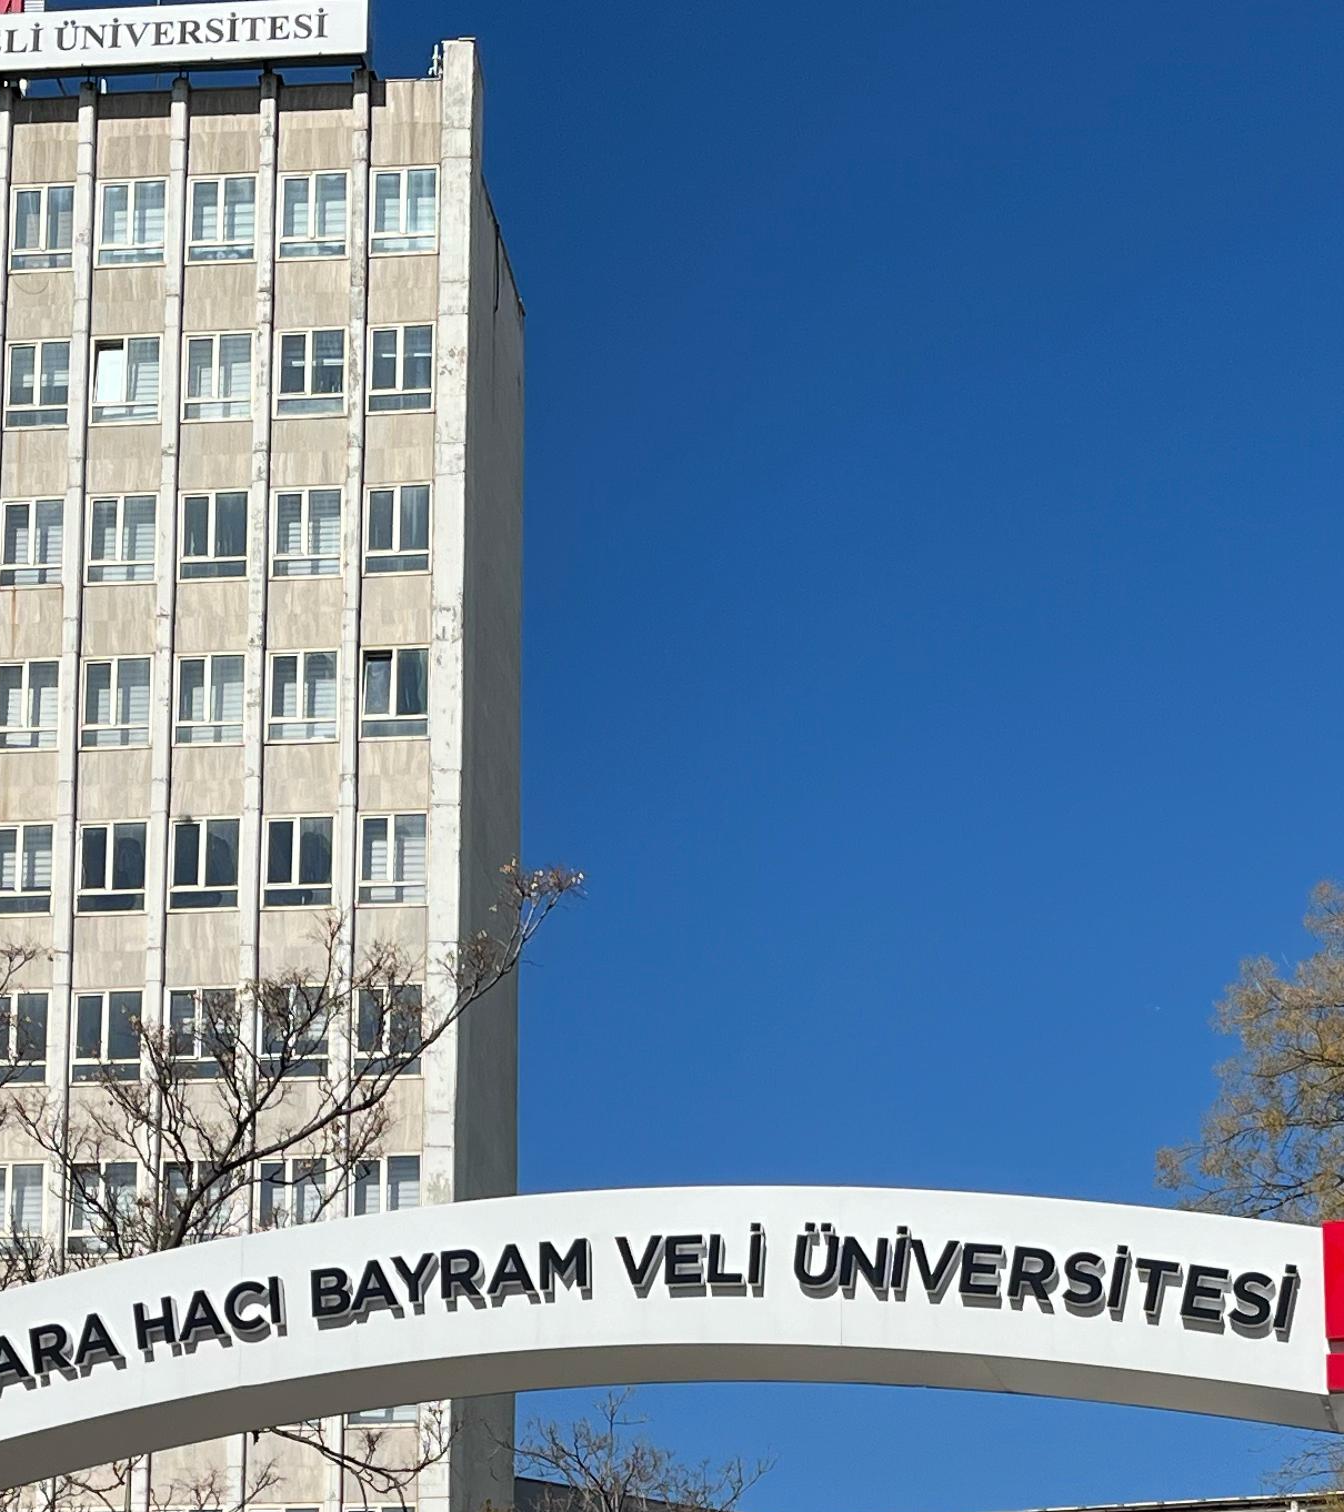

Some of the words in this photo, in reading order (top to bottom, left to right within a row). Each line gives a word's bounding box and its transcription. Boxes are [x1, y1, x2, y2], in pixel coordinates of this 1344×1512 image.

[55, 7, 329, 52] ÜNİVERSİTESİ
[133, 1275, 283, 1353] HACI
[311, 1236, 590, 1321] BAYRAM
[615, 1221, 765, 1291] VELİ
[792, 1221, 1299, 1334] ÜNİVERSİTESİ
